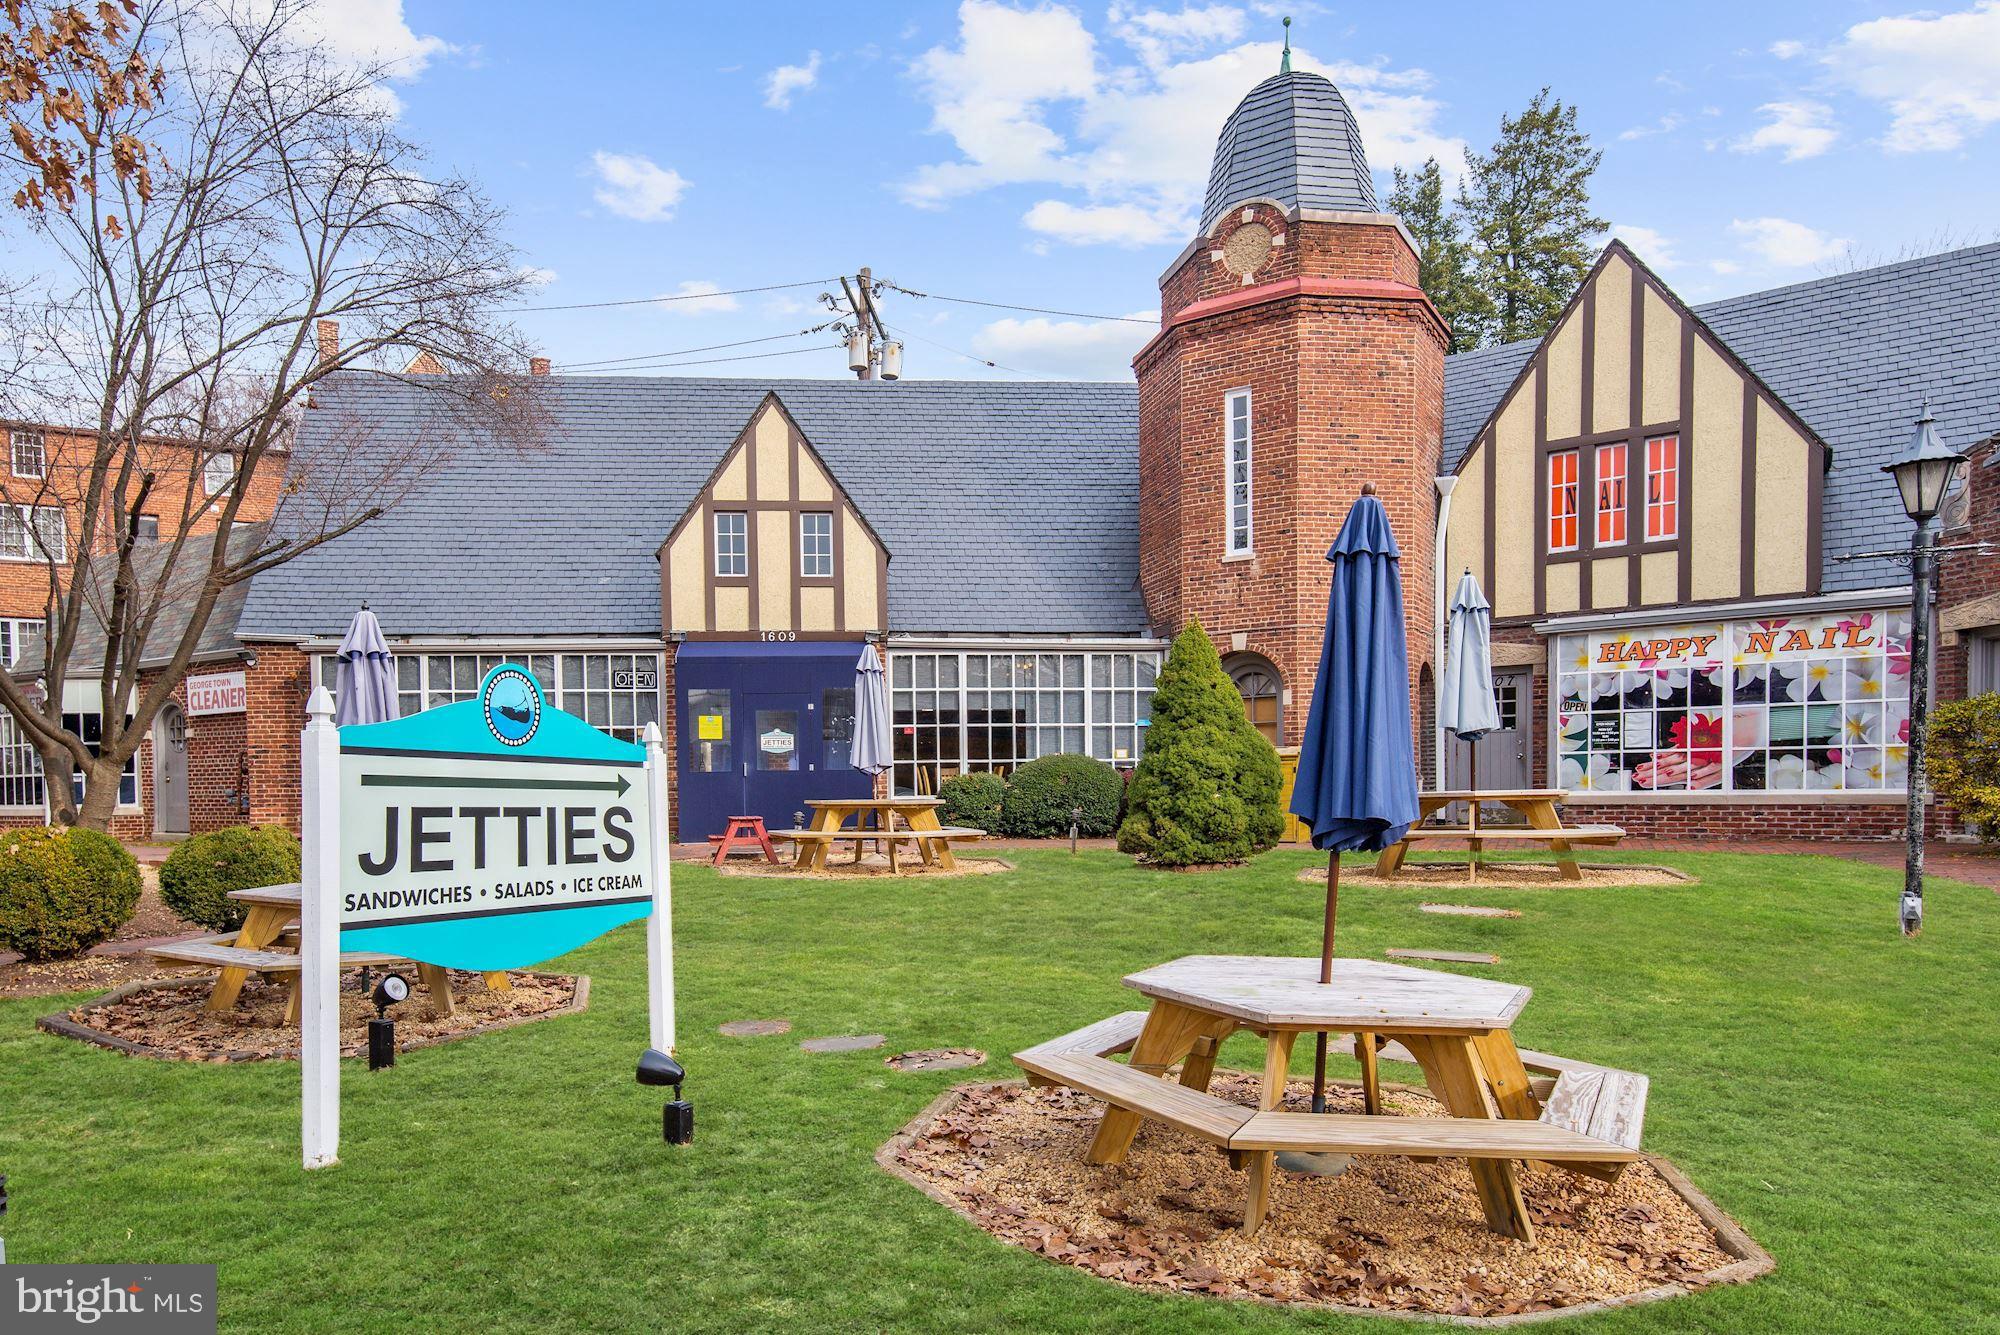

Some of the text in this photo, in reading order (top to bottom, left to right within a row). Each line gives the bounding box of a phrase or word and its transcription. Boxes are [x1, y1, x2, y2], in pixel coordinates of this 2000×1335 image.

[760, 631, 796, 642] 1609
[1597, 625, 1874, 663] HAPPY NAIL
[617, 673, 654, 686] OPEN
[190, 687, 246, 711] CLEANER
[1564, 701, 1587, 712] OPEN
[358, 806, 635, 876] JETTIES
[345, 874, 643, 912] SANDWICHES SALADS ICE CREAM
